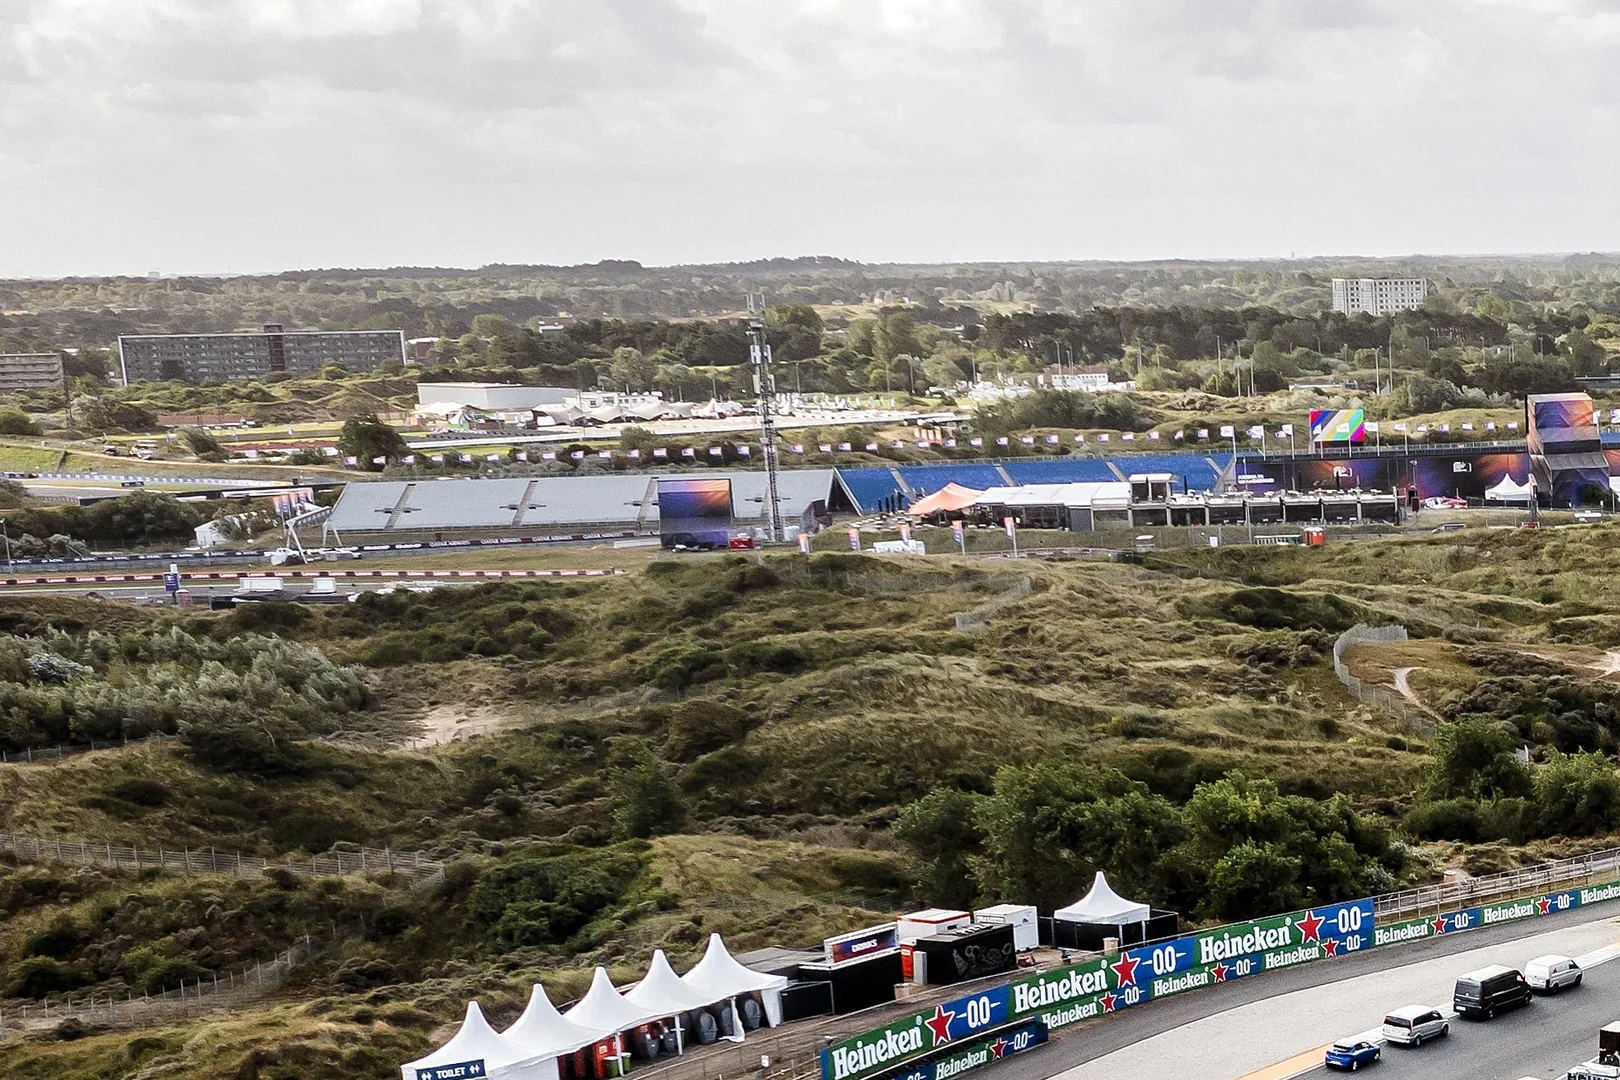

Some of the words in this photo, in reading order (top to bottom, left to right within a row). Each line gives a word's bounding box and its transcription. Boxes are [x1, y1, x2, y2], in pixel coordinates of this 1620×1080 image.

[1484, 903, 1534, 924] Heineken
[1200, 924, 1291, 962] Heineken
[1375, 922, 1429, 944] Heineken
[1265, 944, 1319, 968] Heineken
[1013, 967, 1108, 1010] Heineken
[1154, 970, 1209, 996] Heineken
[831, 1031, 922, 1080] Heineken
[936, 1047, 987, 1080] Heineken
[436, 1066, 466, 1080] TOILET
